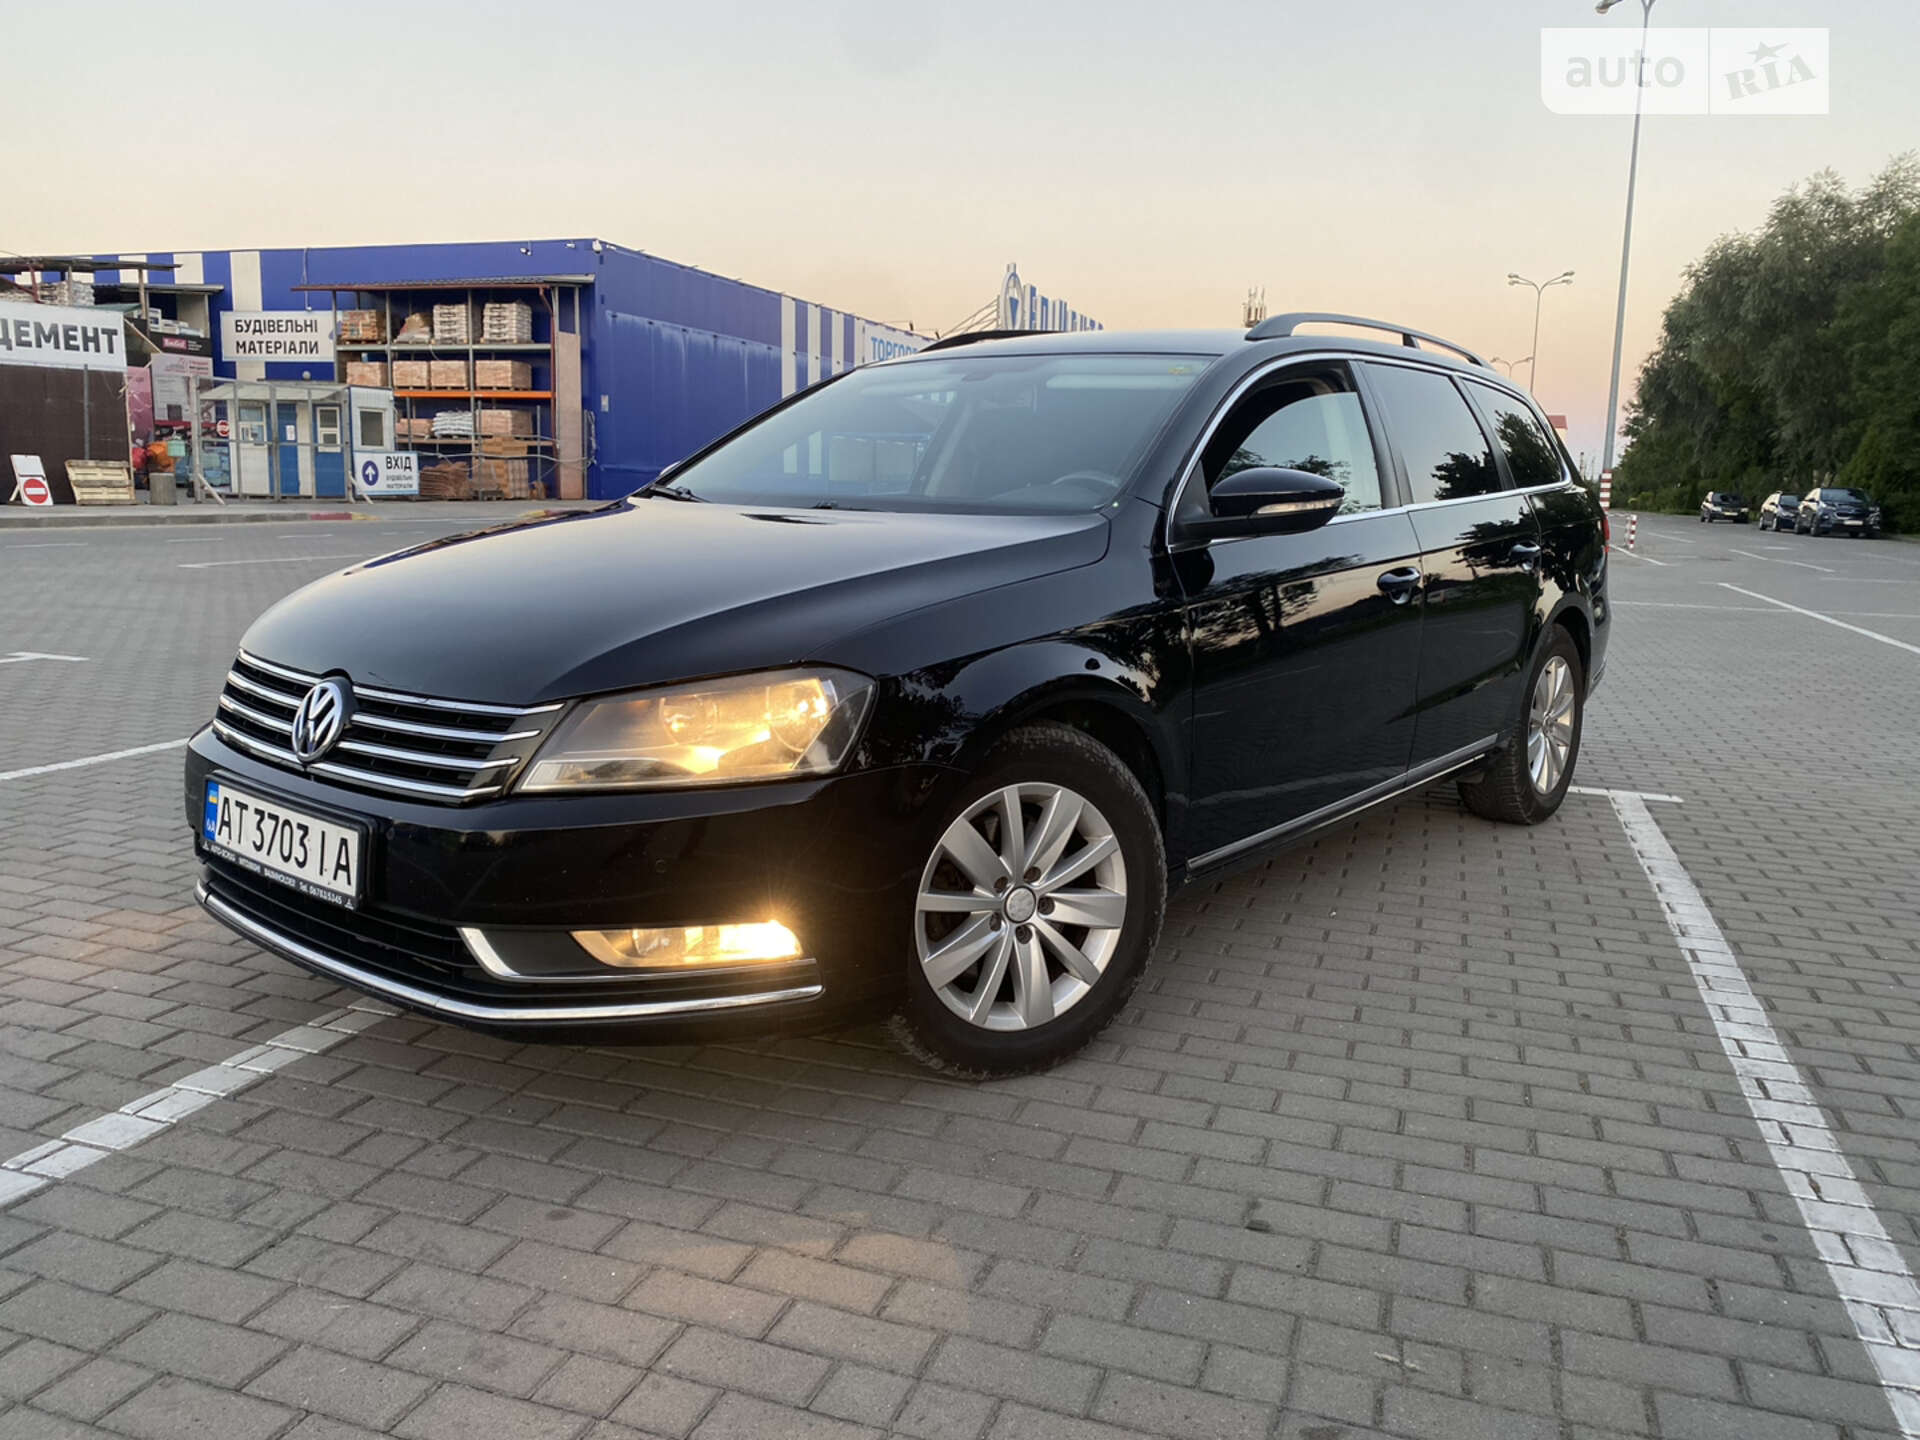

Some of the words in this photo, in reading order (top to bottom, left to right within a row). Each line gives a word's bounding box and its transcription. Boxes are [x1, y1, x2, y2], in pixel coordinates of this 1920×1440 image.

[235, 319, 318, 335] БУДІВЕЛЬНІ
[236, 340, 319, 354] МАТЕРІАЛИ
[385, 456, 412, 471] ВХІД
[217, 796, 249, 845] AT
[252, 808, 310, 869] 3703
[319, 830, 352, 886] IA
